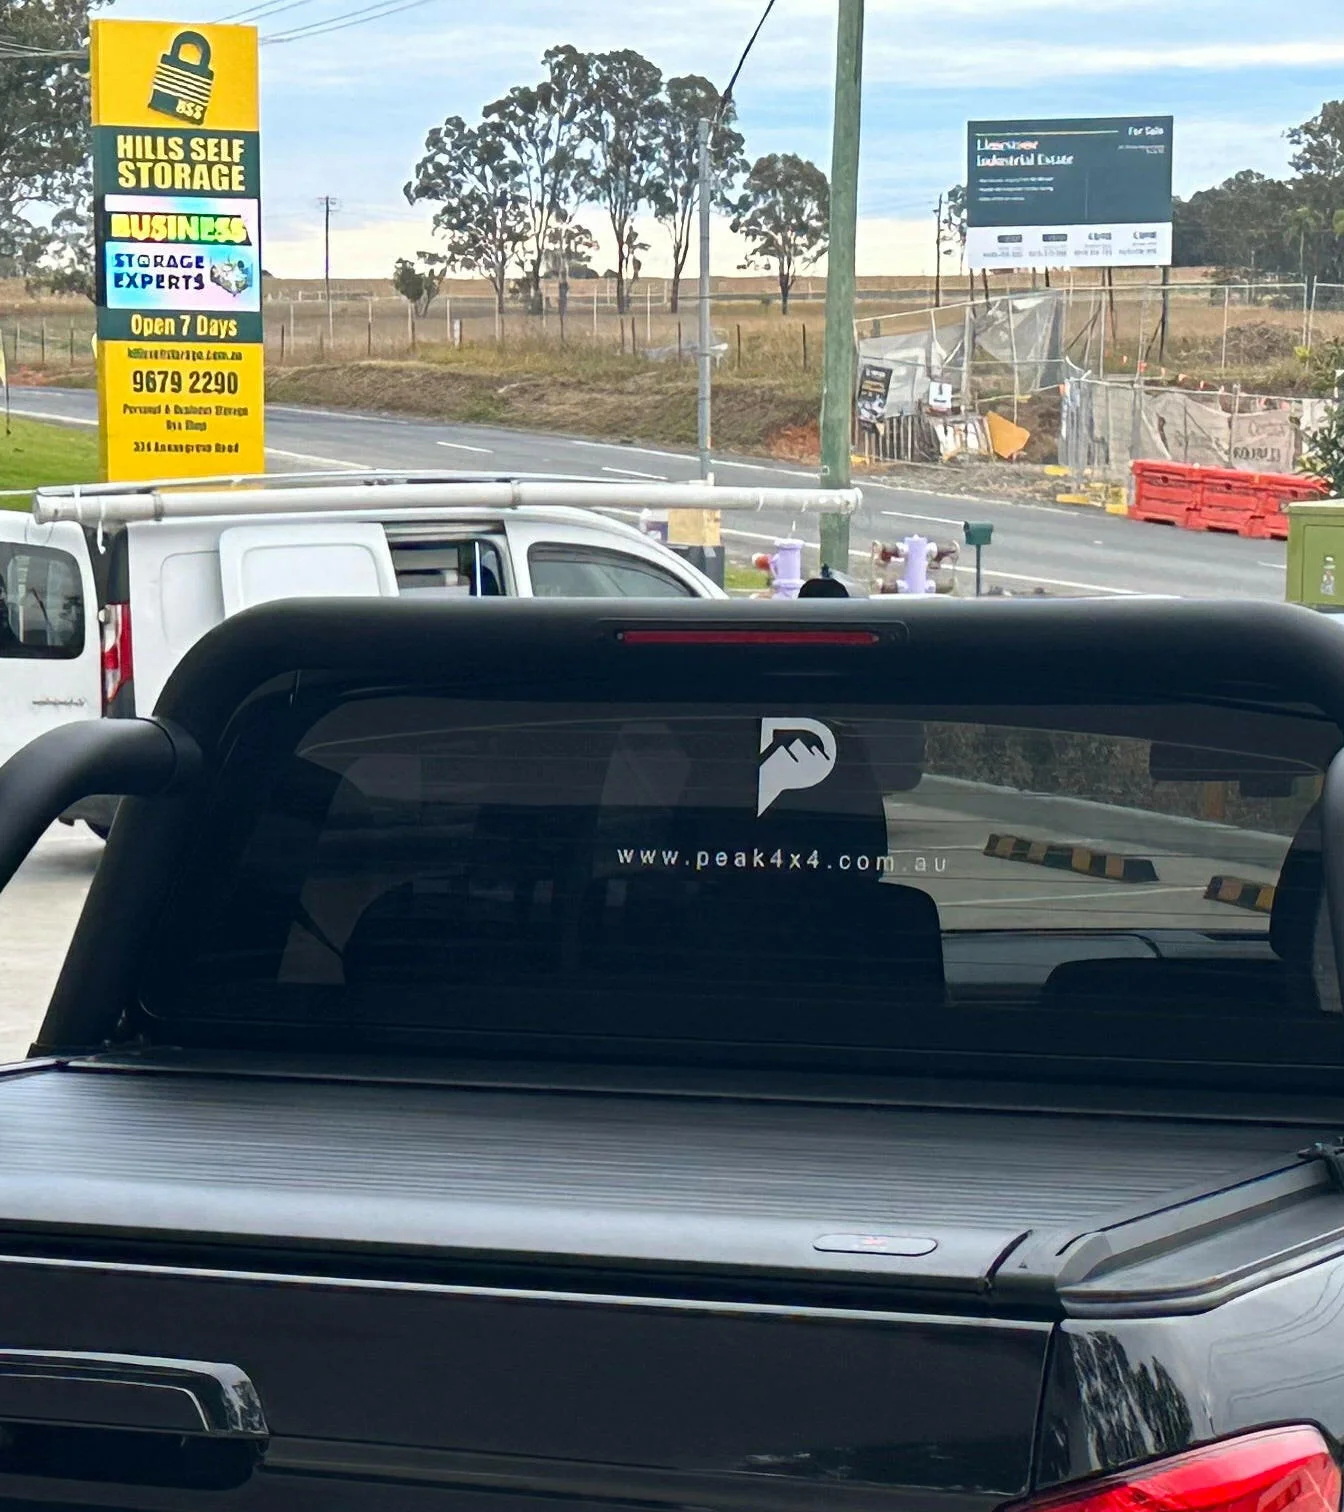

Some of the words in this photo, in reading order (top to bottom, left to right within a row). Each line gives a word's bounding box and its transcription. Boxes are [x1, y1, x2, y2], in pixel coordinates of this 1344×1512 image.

[116, 134, 185, 161] HILLS
[189, 136, 245, 163] SELF
[117, 160, 246, 192] STORAGE
[110, 213, 248, 244] BUSINESS
[113, 253, 205, 269] STORAGE
[113, 272, 205, 290] EXPERTS
[131, 313, 176, 337] Open
[179, 315, 192, 336] 7
[196, 314, 238, 339] Days
[132, 370, 183, 393] 9679
[188, 371, 239, 394] 2290
[616, 847, 947, 873] www.peak4x4.com.au
